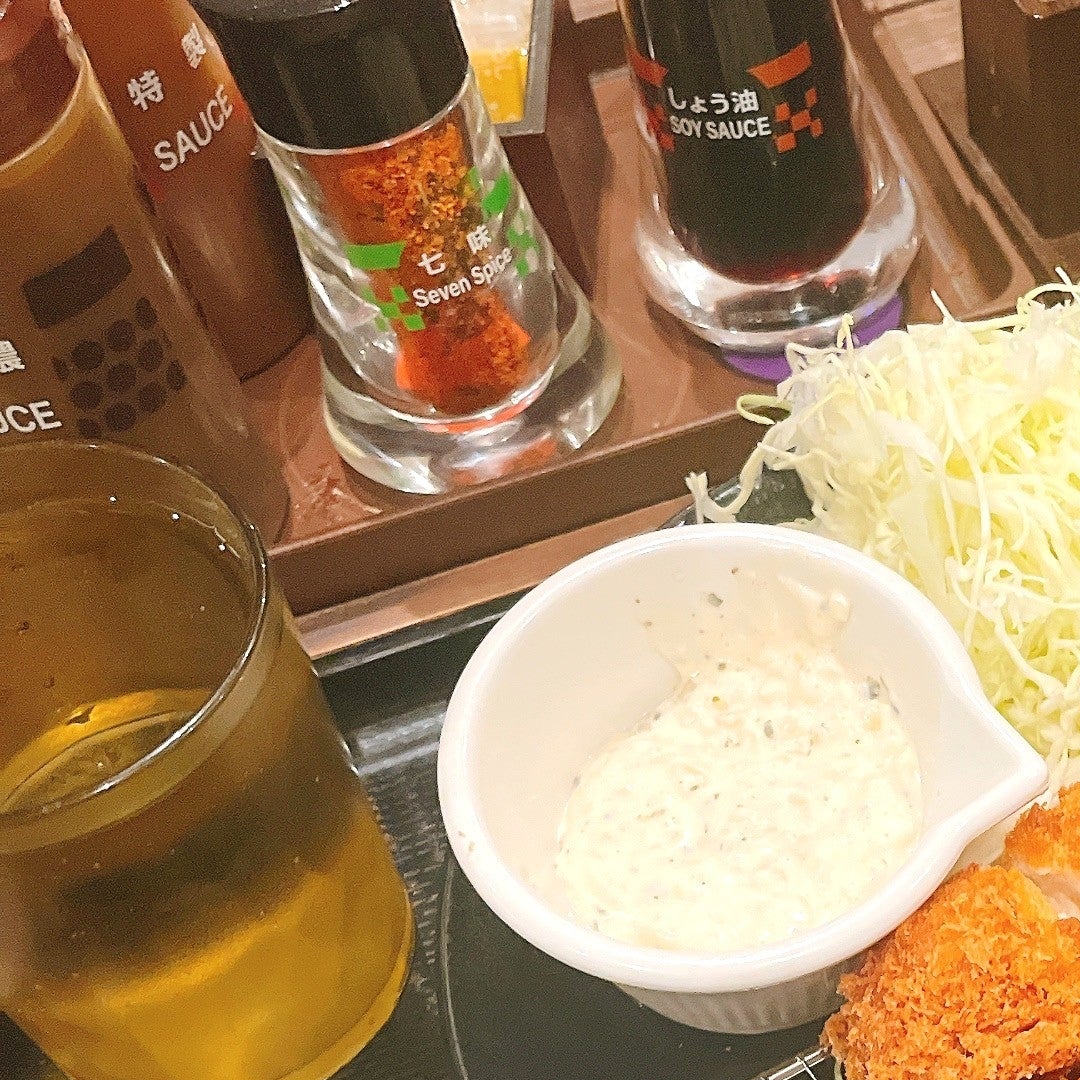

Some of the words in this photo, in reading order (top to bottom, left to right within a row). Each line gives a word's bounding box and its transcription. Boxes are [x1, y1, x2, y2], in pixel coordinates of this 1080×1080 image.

[667, 87, 759, 114] しょう油
[153, 84, 234, 172] SAUCE
[669, 115, 702, 139] SOY
[705, 116, 772, 140] SAUCE
[417, 224, 492, 275] 七味
[412, 276, 472, 308] Seven
[470, 247, 513, 285] Spice
